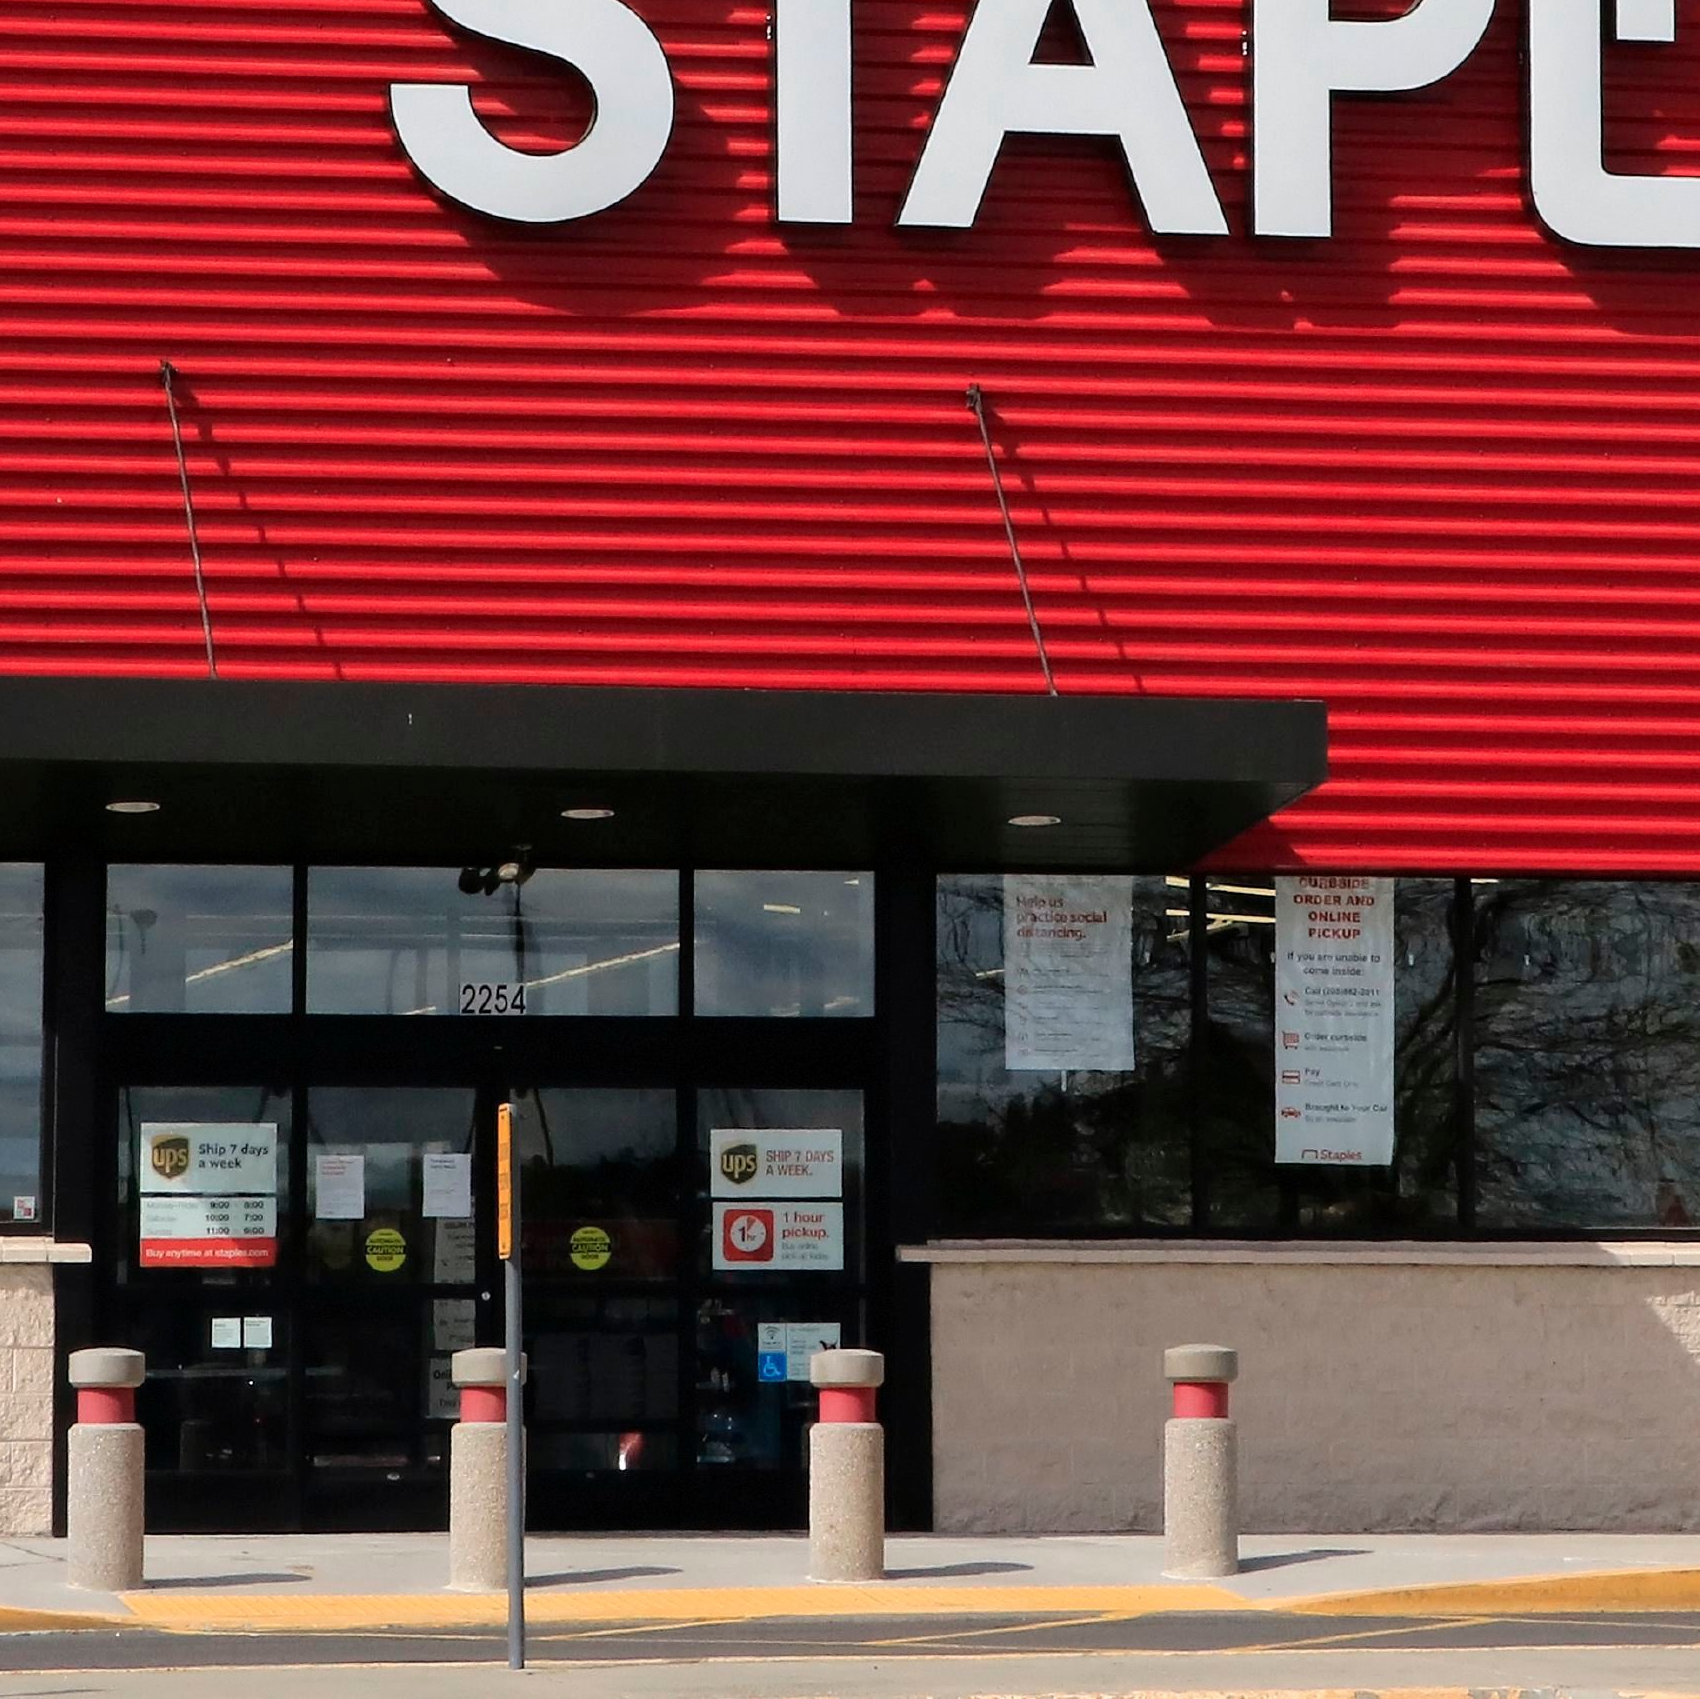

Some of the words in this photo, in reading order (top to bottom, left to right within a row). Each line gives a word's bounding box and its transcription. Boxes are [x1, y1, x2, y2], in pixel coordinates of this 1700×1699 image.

[1017, 895, 1045, 909] Help
[1050, 897, 1064, 908] us
[1293, 894, 1342, 906] ORDER
[1346, 895, 1375, 906] AND
[1017, 911, 1067, 925] practice
[1070, 911, 1107, 923] social
[1308, 911, 1361, 923] ONLINE
[1017, 926, 1087, 941] distancing.
[1308, 928, 1361, 939] PICKUP
[1297, 953, 1315, 962] you
[1318, 953, 1333, 961] are
[1335, 952, 1368, 961] unable
[1370, 953, 1381, 962] to
[1303, 967, 1330, 975] come
[461, 984, 526, 1014] 2254
[198, 1143, 226, 1156] Ship
[230, 1144, 237, 1154] 7
[241, 1143, 269, 1156] days
[153, 1148, 188, 1173] ups
[766, 1150, 791, 1162] SHIP
[795, 1151, 801, 1162] 7
[805, 1150, 834, 1163] DAYS
[1320, 1150, 1362, 1162] Staples
[198, 1160, 205, 1168] a
[209, 1158, 242, 1169] week
[723, 1154, 757, 1179] ups
[766, 1165, 773, 1176] A
[777, 1165, 812, 1176] WEEK.
[205, 1213, 230, 1222] 10:00
[244, 1214, 264, 1222] 7:00
[784, 1212, 789, 1223] 1
[794, 1211, 825, 1223] hour
[205, 1226, 230, 1235] 11:00
[782, 1226, 829, 1240] pickup.
[146, 1248, 164, 1258] Buy
[166, 1249, 202, 1258] anytime
[204, 1248, 213, 1257] at
[215, 1248, 268, 1259] staples.com
[366, 1246, 404, 1254] CAUTION
